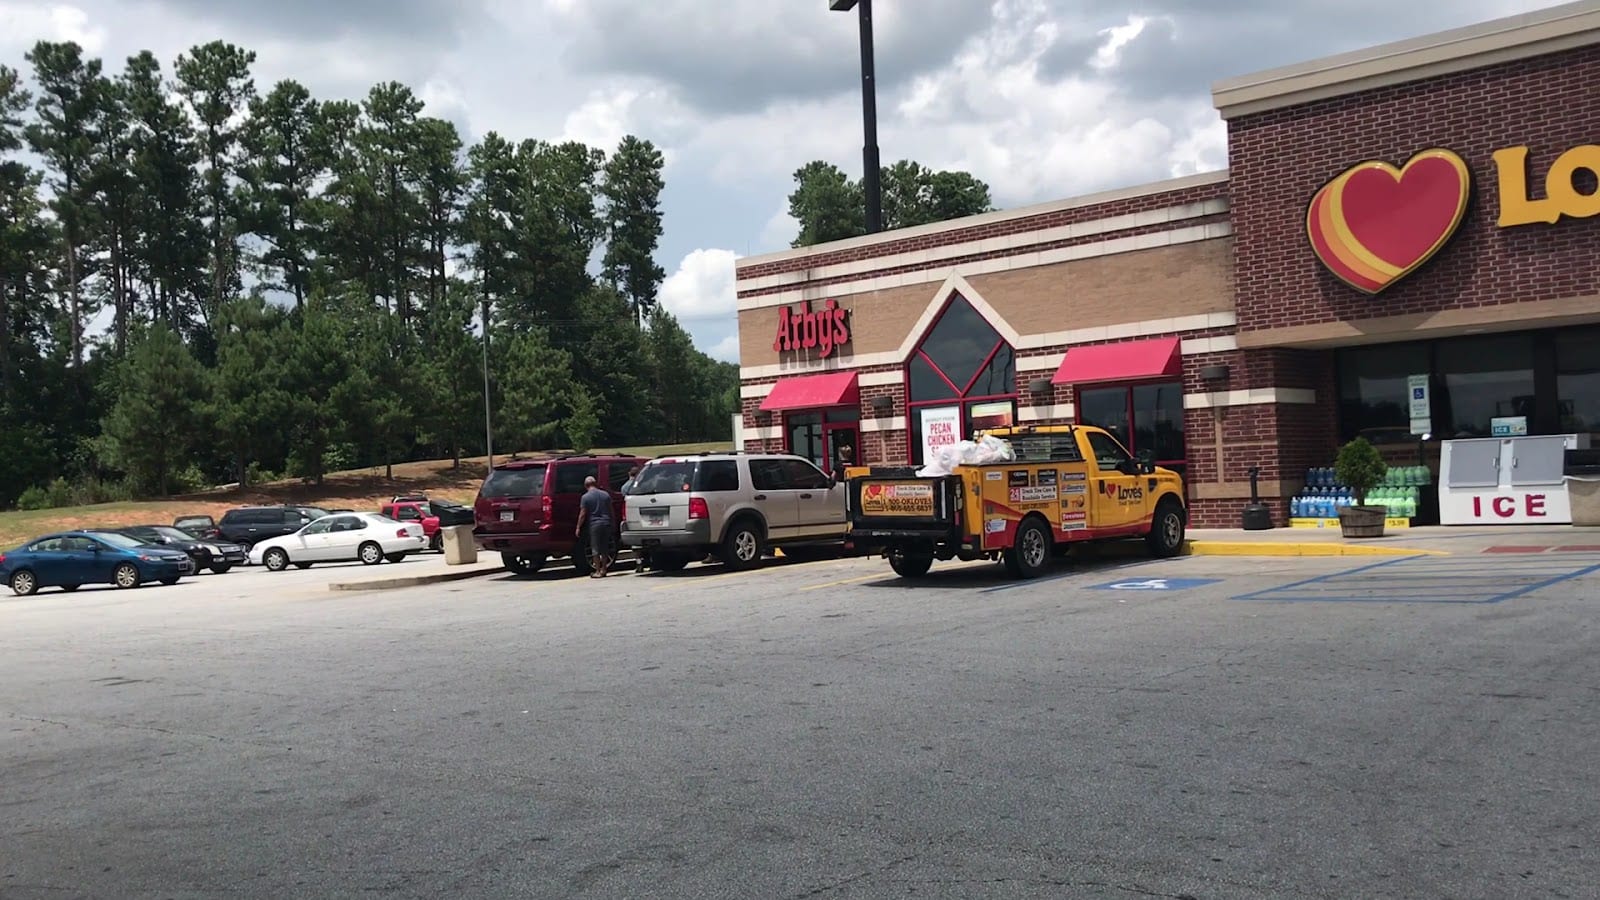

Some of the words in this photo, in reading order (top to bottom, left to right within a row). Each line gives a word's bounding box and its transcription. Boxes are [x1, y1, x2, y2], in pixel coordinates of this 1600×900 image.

[773, 298, 848, 358] Arby's
[930, 422, 952, 435] PECAN
[927, 434, 955, 447] CHICKEN
[1473, 494, 1547, 518] ICE
